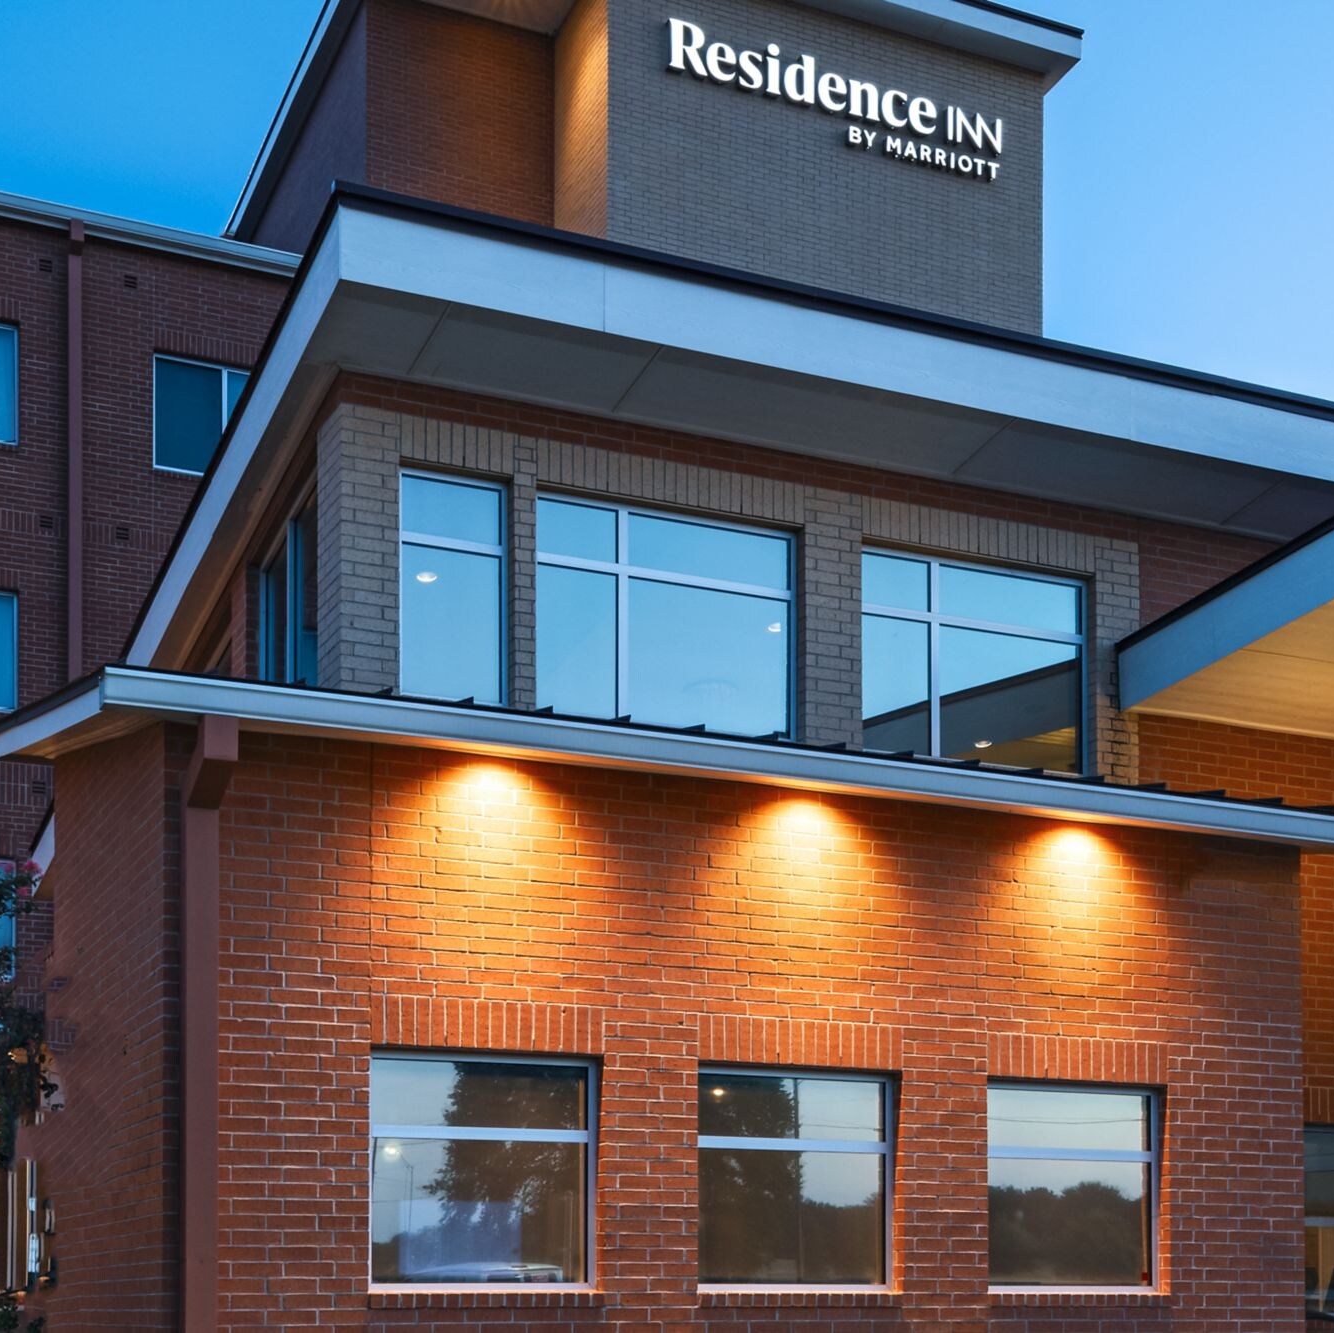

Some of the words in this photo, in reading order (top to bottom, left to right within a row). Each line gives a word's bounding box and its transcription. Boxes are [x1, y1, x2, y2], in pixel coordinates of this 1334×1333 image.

[669, 17, 937, 135] Residence
[946, 105, 1003, 154] INN
[848, 125, 877, 147] BY
[886, 135, 1001, 180] MARRIOTT
